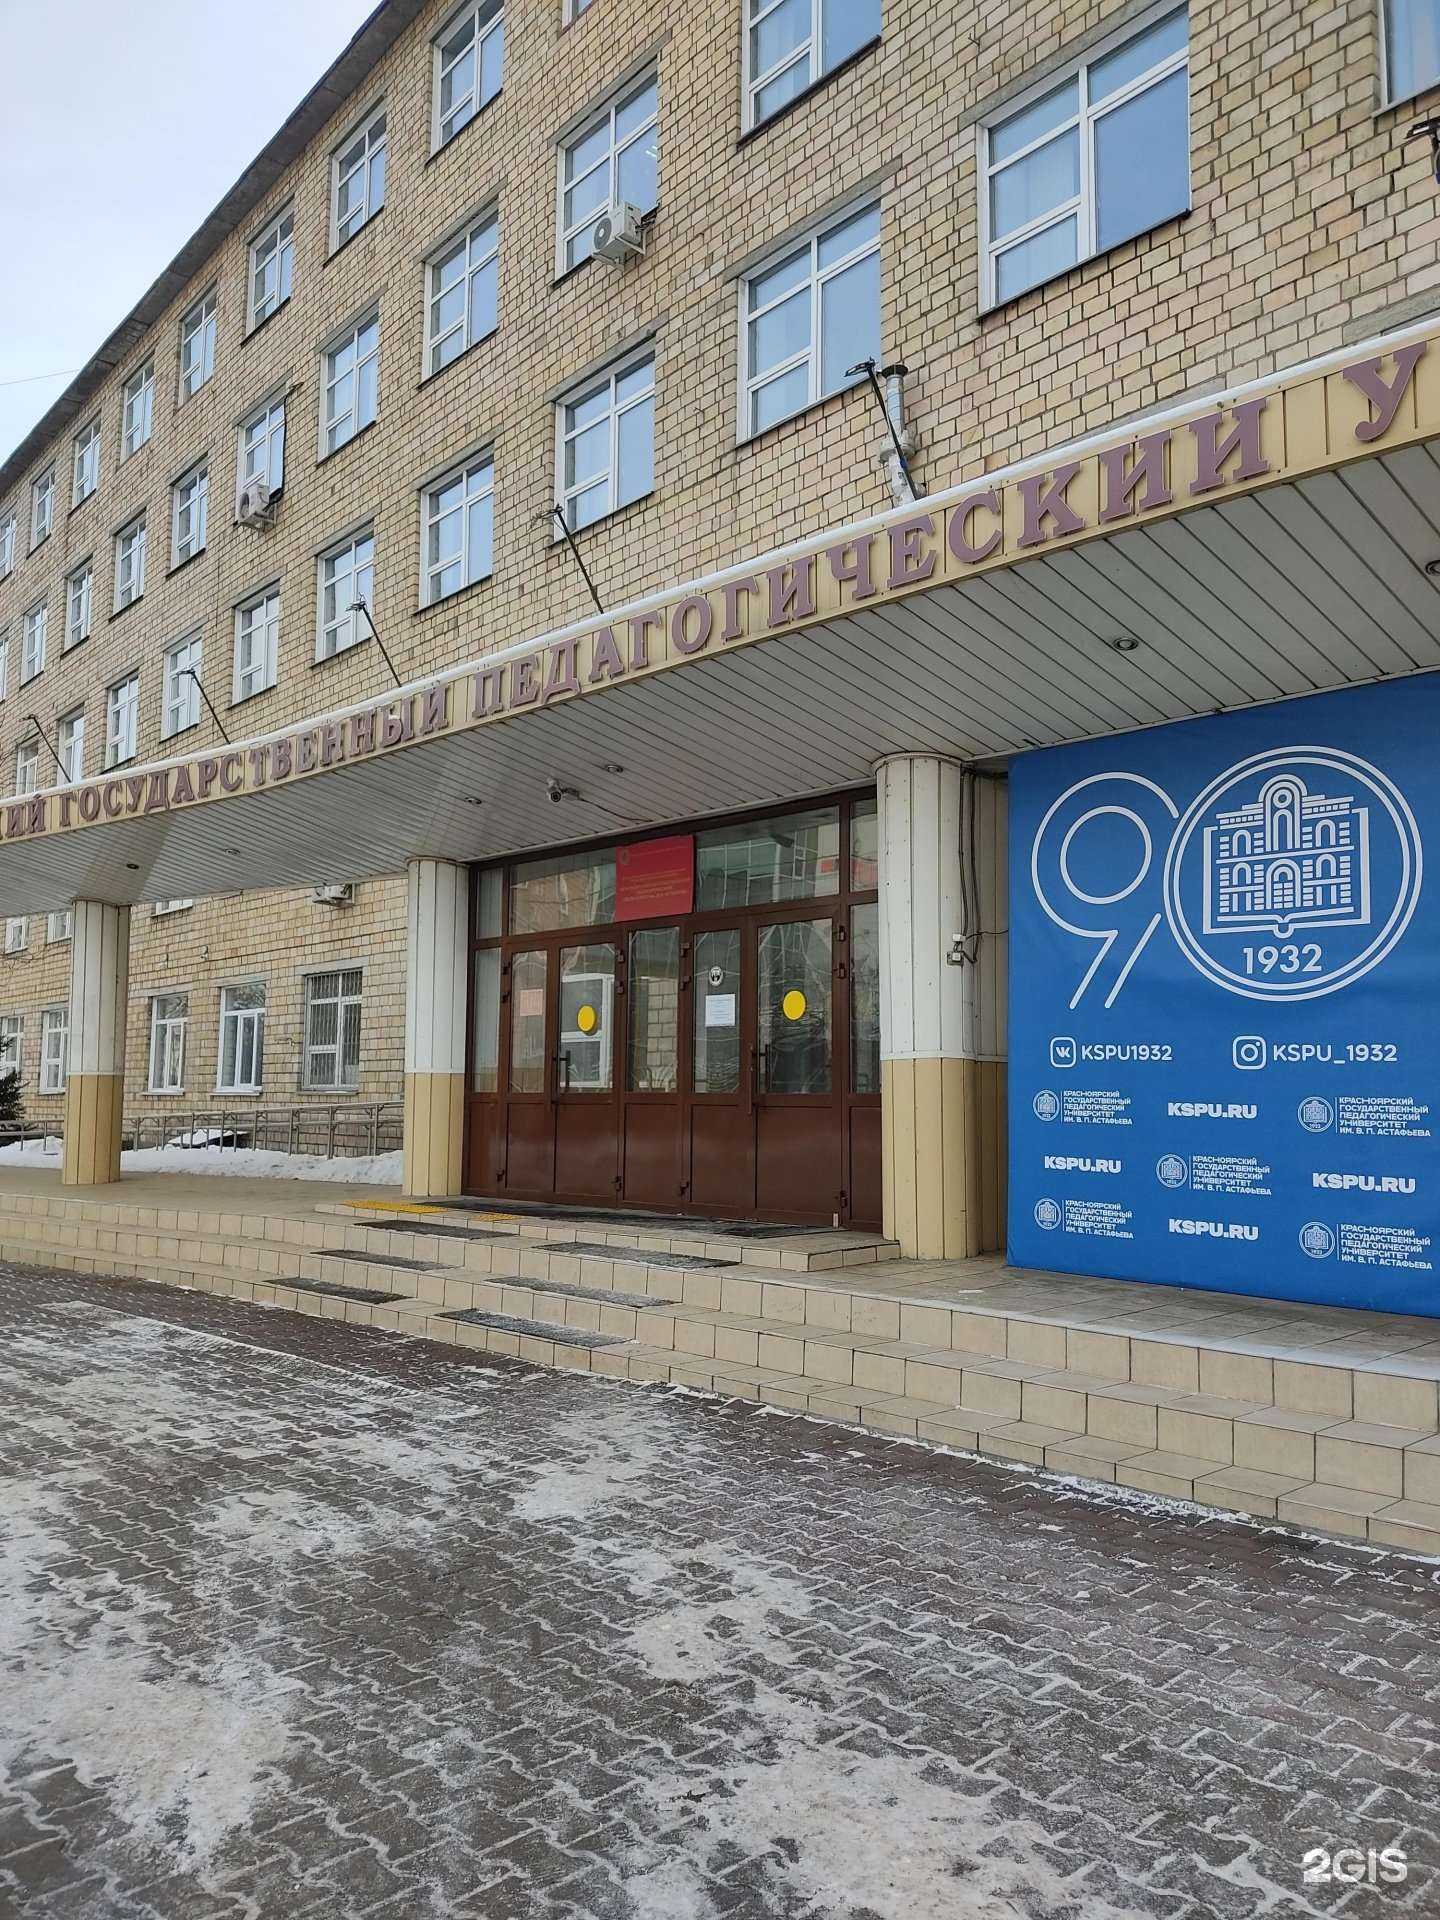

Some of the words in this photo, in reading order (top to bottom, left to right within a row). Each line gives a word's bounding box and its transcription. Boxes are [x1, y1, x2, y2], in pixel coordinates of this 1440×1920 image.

[0, 793, 46, 838] ИЙ
[1342, 340, 1428, 442] У
[1243, 943, 1322, 974] 1932
[1081, 1045, 1173, 1061] KSPU1932
[1273, 1044, 1398, 1064] KSPU_1932
[1339, 1097, 1414, 1105] КРАСНОЯРСКИЙ
[1167, 1102, 1258, 1120] KSPU.RU
[1339, 1104, 1429, 1114] ГОСУДАРСТВЕННЫЙ
[1339, 1112, 1421, 1121] ПЕДАГОГИЧЕСКИЙ
[1339, 1120, 1408, 1128] УНИВЕРСИТЕТ
[1044, 1155, 1122, 1174] KSPU.RU
[1192, 1155, 1257, 1165] КРАСНОЯРСКИЙ
[1192, 1162, 1271, 1173] ГОСУДАРСТВЕННЫЙ
[1192, 1169, 1263, 1180] ПЕДАГОГИЧЕСКИЙ
[1192, 1176, 1252, 1186] УНИВЕРСИТЕТ
[1312, 1172, 1416, 1194] KSPU.RU
[1168, 1218, 1259, 1241] KSPU.RU
[1340, 1223, 1415, 1236] КРАСНОЯРСКИЙ
[1340, 1231, 1431, 1246] ГОСУДАРСТВЕННЫЙ
[1341, 1239, 1423, 1253] ПЕДАГОГИЧЕСКИЙ
[1341, 1247, 1409, 1260] УНИВЕРСИТЕТ
[1342, 1255, 1357, 1263] ИМ.
[1368, 1257, 1377, 1265] П.
